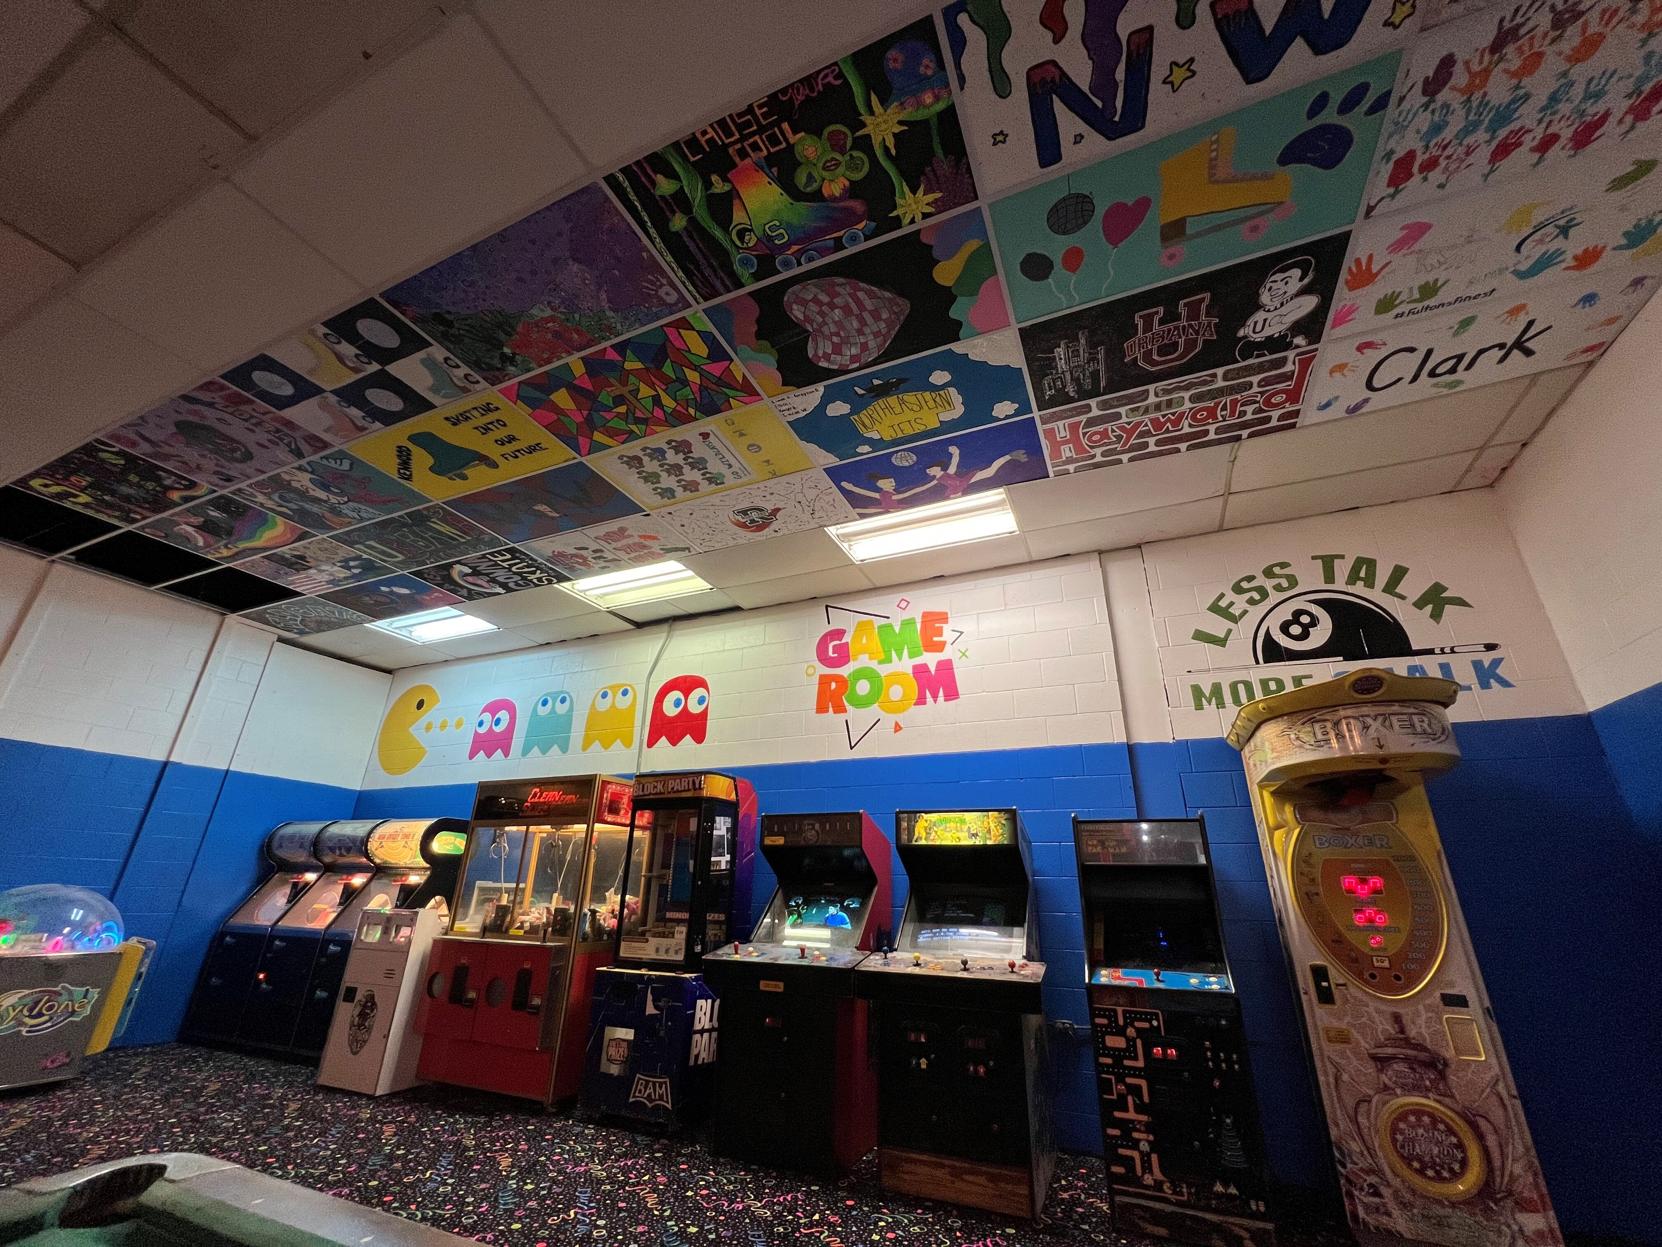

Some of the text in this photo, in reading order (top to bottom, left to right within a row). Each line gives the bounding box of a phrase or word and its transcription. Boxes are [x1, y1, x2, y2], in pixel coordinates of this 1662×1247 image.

[680, 97, 778, 162] CAUSE
[1124, 319, 1219, 361] URBANA
[1365, 319, 1553, 392] Clark
[444, 402, 501, 426] SKATING
[853, 388, 955, 431] NORTHEASTERN
[1043, 351, 1319, 462] Hayward
[473, 419, 508, 437] INTO
[494, 434, 521, 446] OUR
[890, 418, 928, 440] JETS
[500, 442, 549, 462] FUTURE
[486, 550, 558, 586] SKATE
[1191, 554, 1474, 648] LESS TALK
[816, 611, 949, 668] GAME
[1279, 608, 1320, 641] 8
[815, 659, 960, 715] ROOM
[1311, 713, 1436, 742] BOXER
[633, 775, 705, 797] BLOCK PARTY!
[1312, 834, 1392, 849] BOXER
[635, 1079, 668, 1101] BAM
